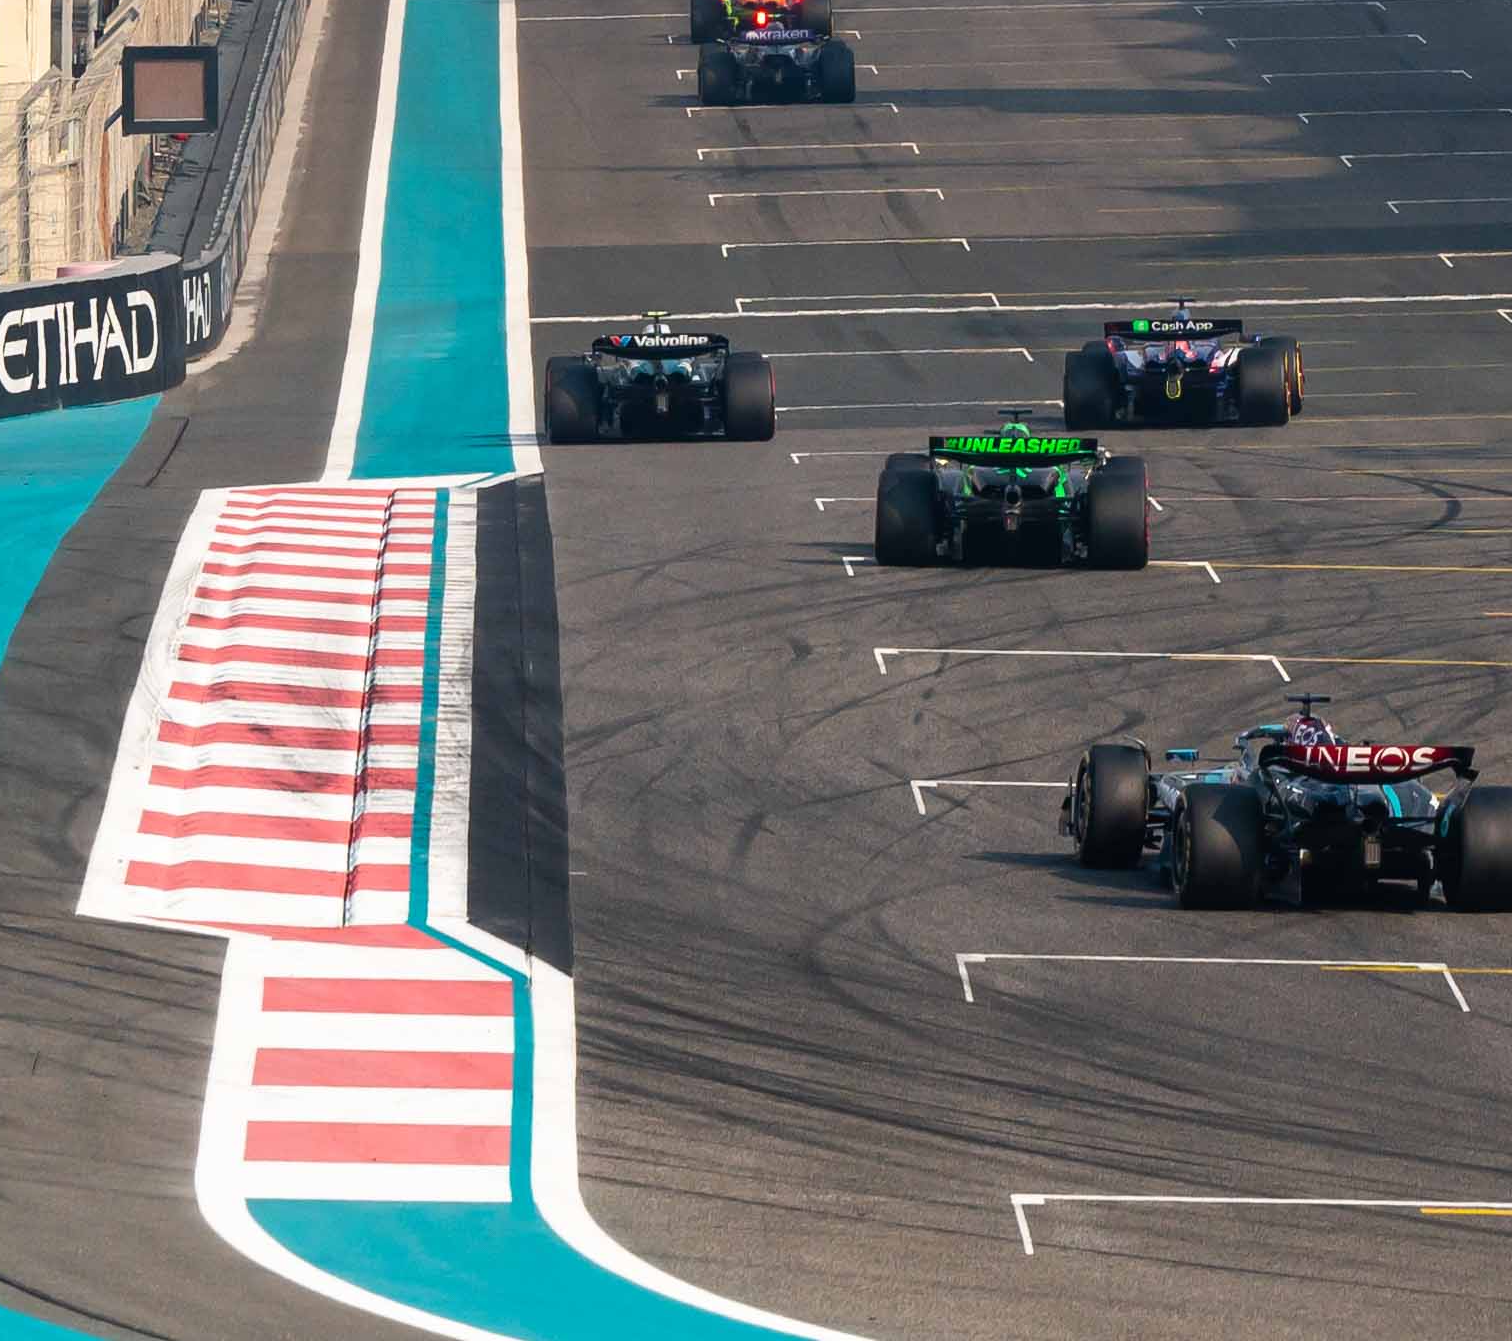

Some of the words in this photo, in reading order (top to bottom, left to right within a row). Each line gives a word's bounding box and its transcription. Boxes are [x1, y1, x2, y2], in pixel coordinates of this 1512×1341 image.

[1151, 320, 1183, 332] Cash
[1186, 320, 1214, 331] App
[634, 334, 709, 348] Valvoline
[944, 436, 1081, 454] #UNLEASHED
[1304, 746, 1437, 772] INEOS
